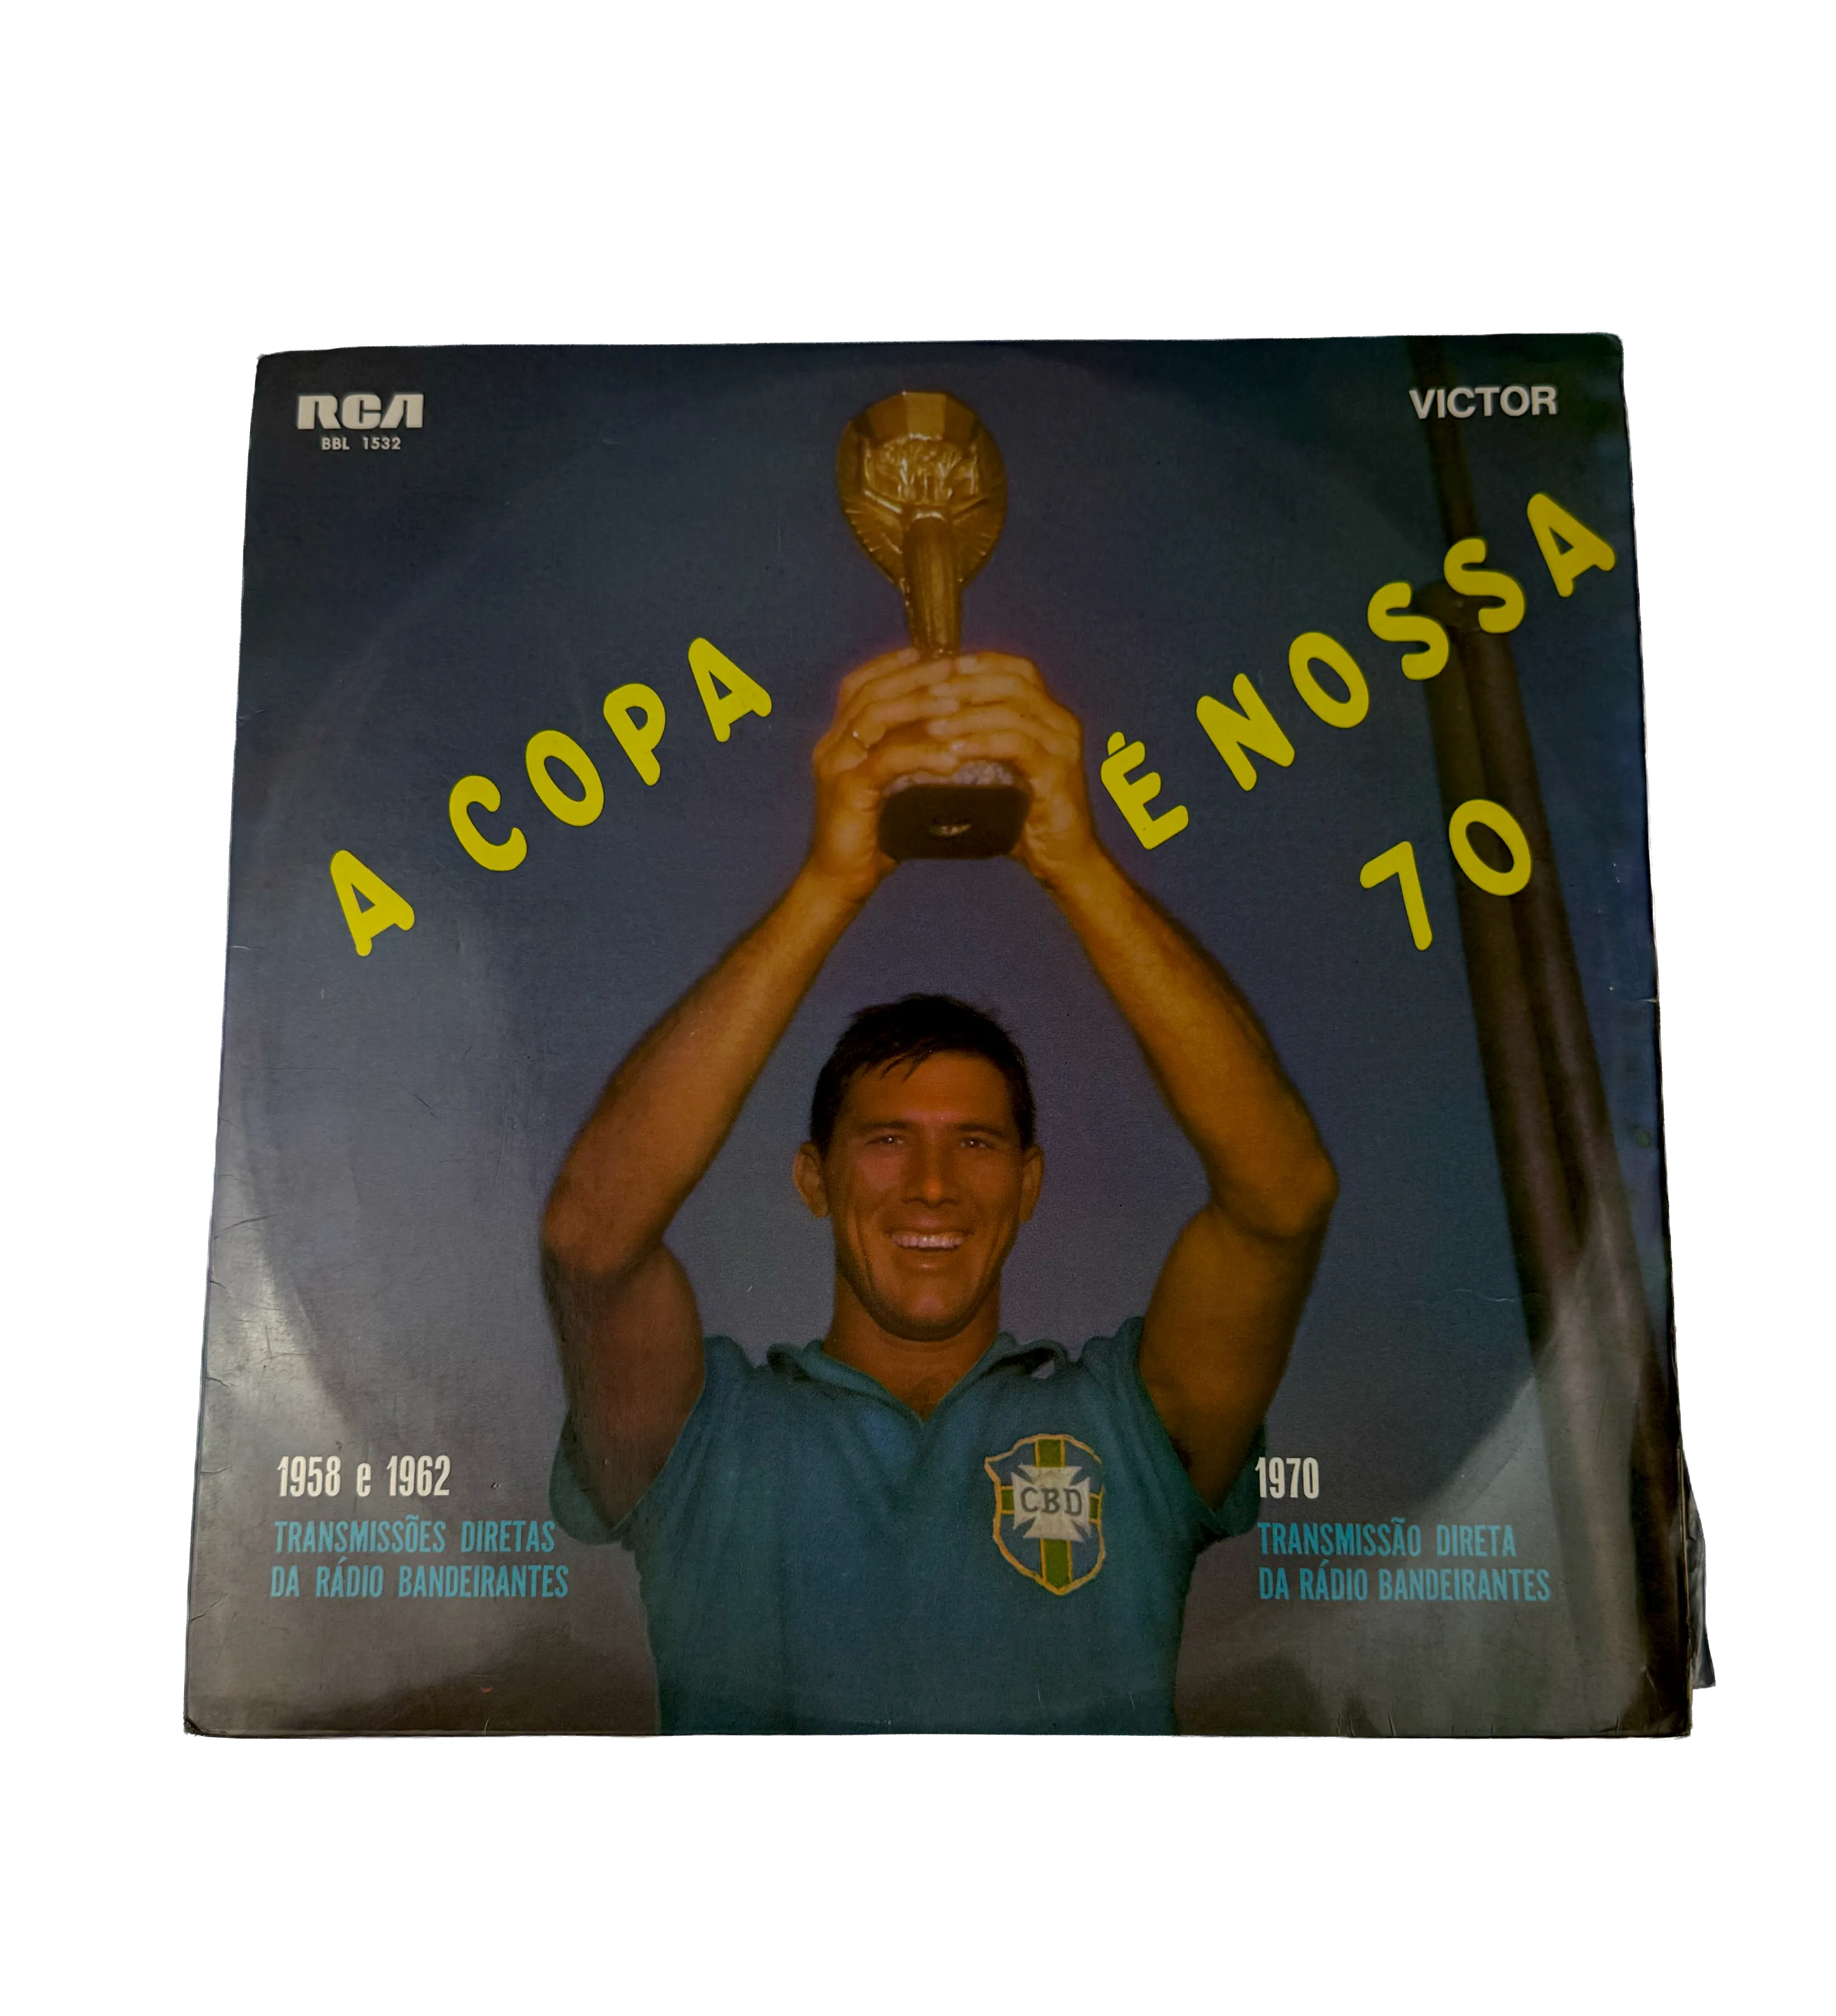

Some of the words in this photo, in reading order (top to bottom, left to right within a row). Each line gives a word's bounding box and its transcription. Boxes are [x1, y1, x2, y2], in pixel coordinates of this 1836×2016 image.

[296, 393, 424, 429] RCA
[1408, 385, 1559, 420] VICTOR
[321, 436, 350, 450] BBL
[362, 436, 401, 450] 1532
[1100, 733, 1189, 850] É
[1196, 493, 1615, 791] NOSSA
[329, 849, 416, 958] A
[449, 637, 772, 872] COPA
[1359, 799, 1532, 951] 70
[277, 1455, 342, 1497] 1958
[356, 1462, 372, 1497] e
[386, 1455, 451, 1496] 1962
[1254, 1456, 1320, 1500] 1970
[1021, 1486, 1082, 1516] CBD
[274, 1514, 446, 1554] TRANSMISSÕES
[461, 1519, 556, 1553] DIRETAS
[1256, 1516, 1421, 1556] TRANSMISSÃO
[1436, 1524, 1517, 1557] DIRETA
[270, 1564, 300, 1598] DA
[316, 1556, 385, 1598] RÁDIO
[398, 1564, 569, 1598] BANDEIRANTES
[1258, 1567, 1290, 1601] DA
[1299, 1558, 1369, 1601] RÁDIO
[1378, 1568, 1552, 1602] BANDEIRANTES
